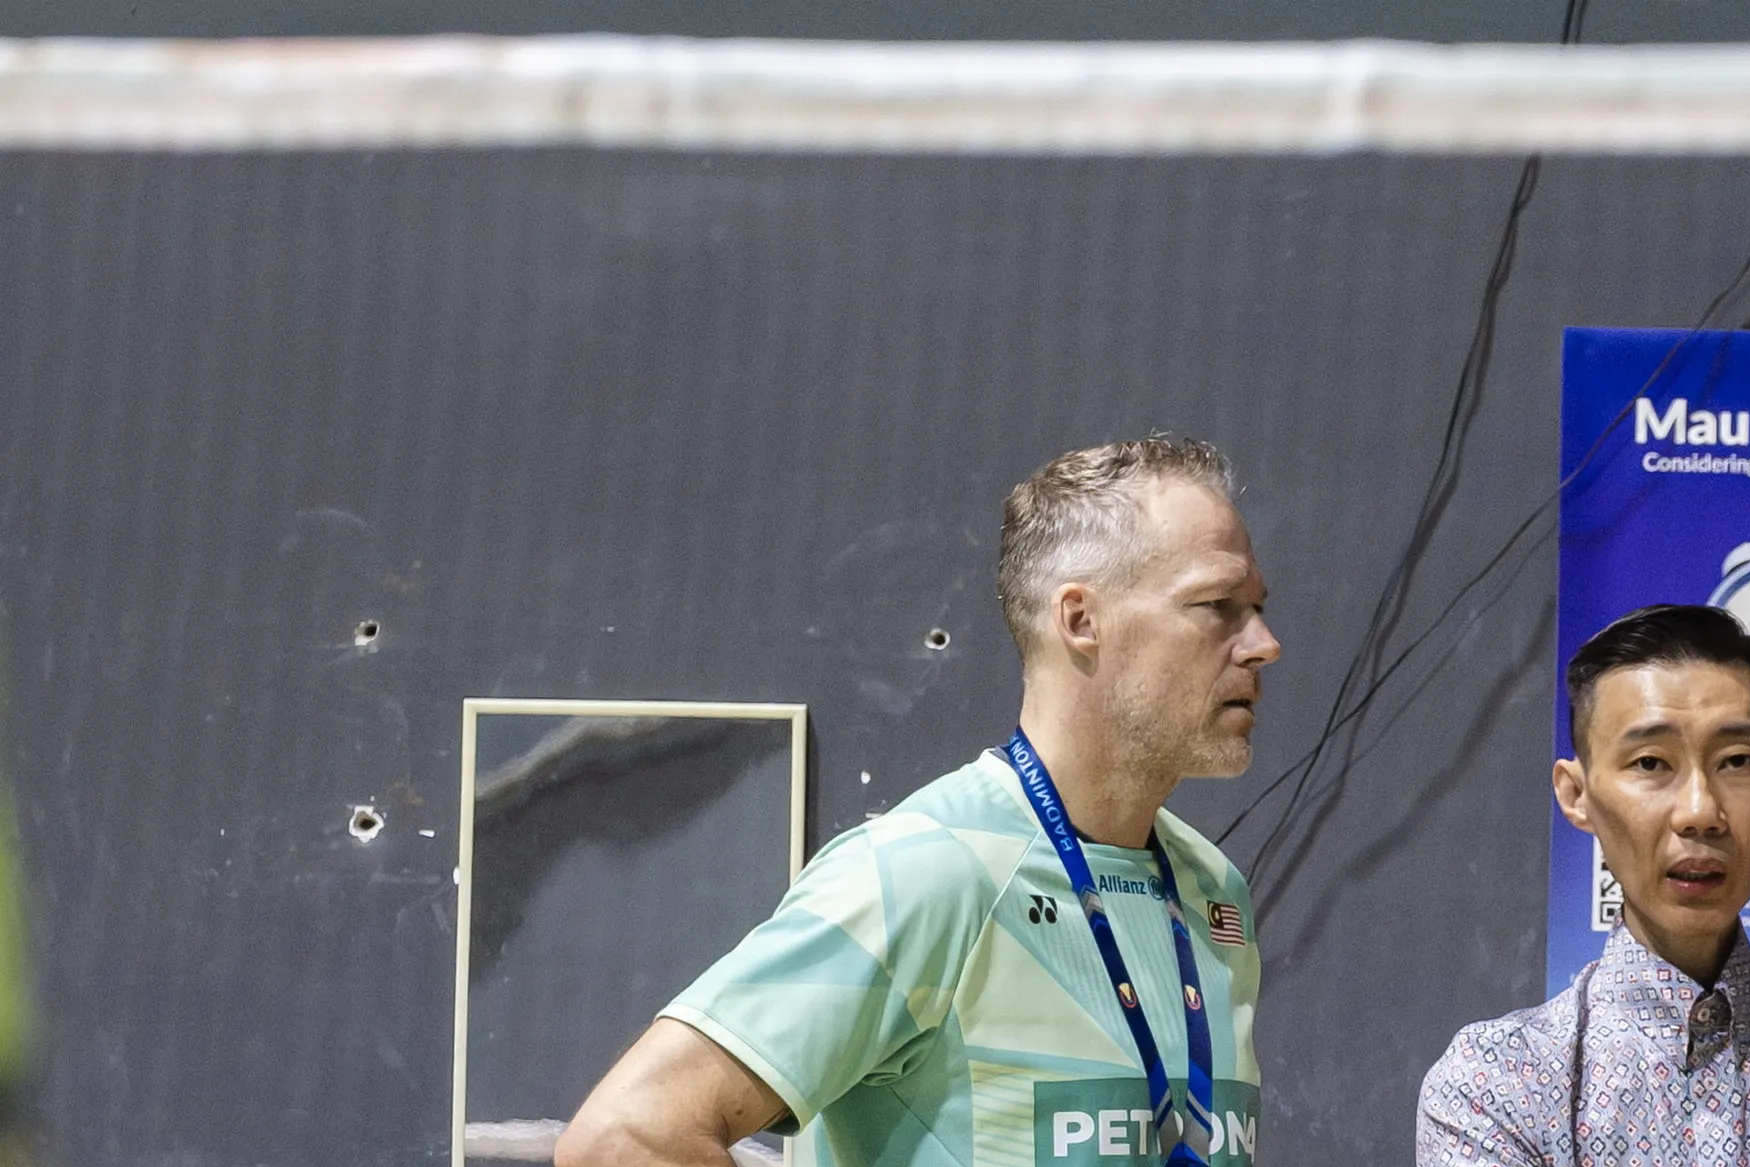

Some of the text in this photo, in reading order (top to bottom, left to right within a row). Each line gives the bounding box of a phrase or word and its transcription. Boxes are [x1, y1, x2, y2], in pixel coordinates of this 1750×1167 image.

[1634, 397, 1750, 445] Mau
[1010, 742, 1074, 851] BADMINTON
[1099, 874, 1147, 895] Allianz
